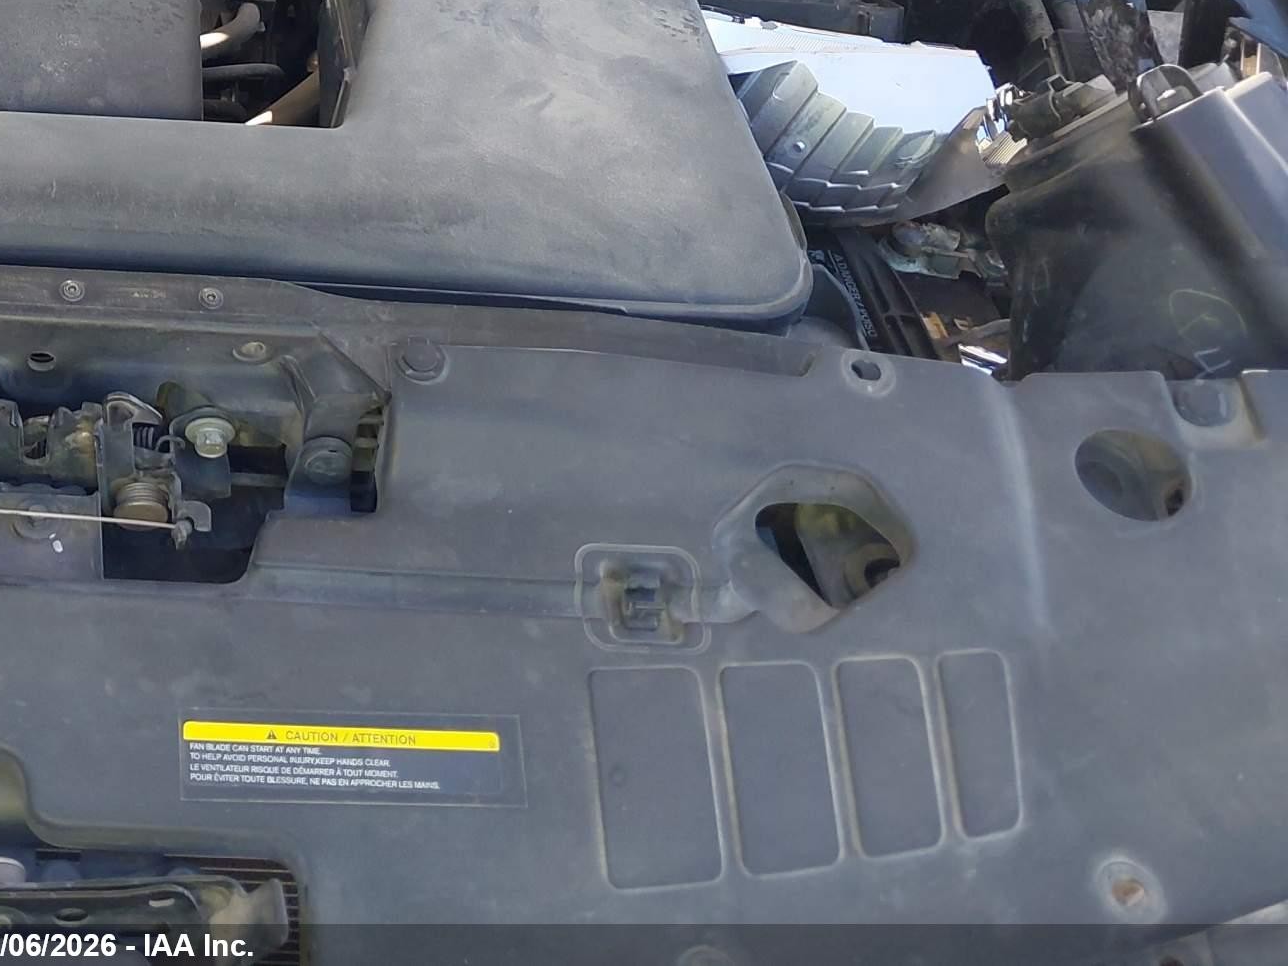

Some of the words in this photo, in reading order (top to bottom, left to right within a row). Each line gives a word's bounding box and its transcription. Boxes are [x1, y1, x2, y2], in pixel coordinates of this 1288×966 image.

[285, 730, 338, 742] CAUTION
[342, 733, 349, 744] /
[352, 733, 416, 746] ATTENTION
[189, 742, 205, 751] FAN
[205, 743, 231, 752] BLADE
[232, 744, 249, 752] CAN
[250, 745, 274, 753] START
[285, 746, 302, 754] ANY
[190, 752, 201, 760] TO
[202, 753, 222, 761] HELP
[222, 754, 246, 762] AVOID
[247, 754, 289, 764] PERSONAL
[336, 758, 363, 766] HANDS
[190, 763, 199, 771] LE
[200, 764, 250, 773] VENTILATEUR
[250, 766, 280, 775] RISQUE
[281, 766, 292, 775] DE
[293, 765, 335, 776] DÉMARRER
[343, 768, 363, 777] TOUT
[190, 772, 213, 781] POUR
[213, 771, 240, 782] ÉVITER
[240, 774, 265, 783] TOUTE
[309, 777, 321, 785] NE
[321, 777, 338, 786] PAS
[338, 778, 350, 786] EN
[350, 778, 398, 788] APPROCHER
[398, 780, 413, 789] LES
